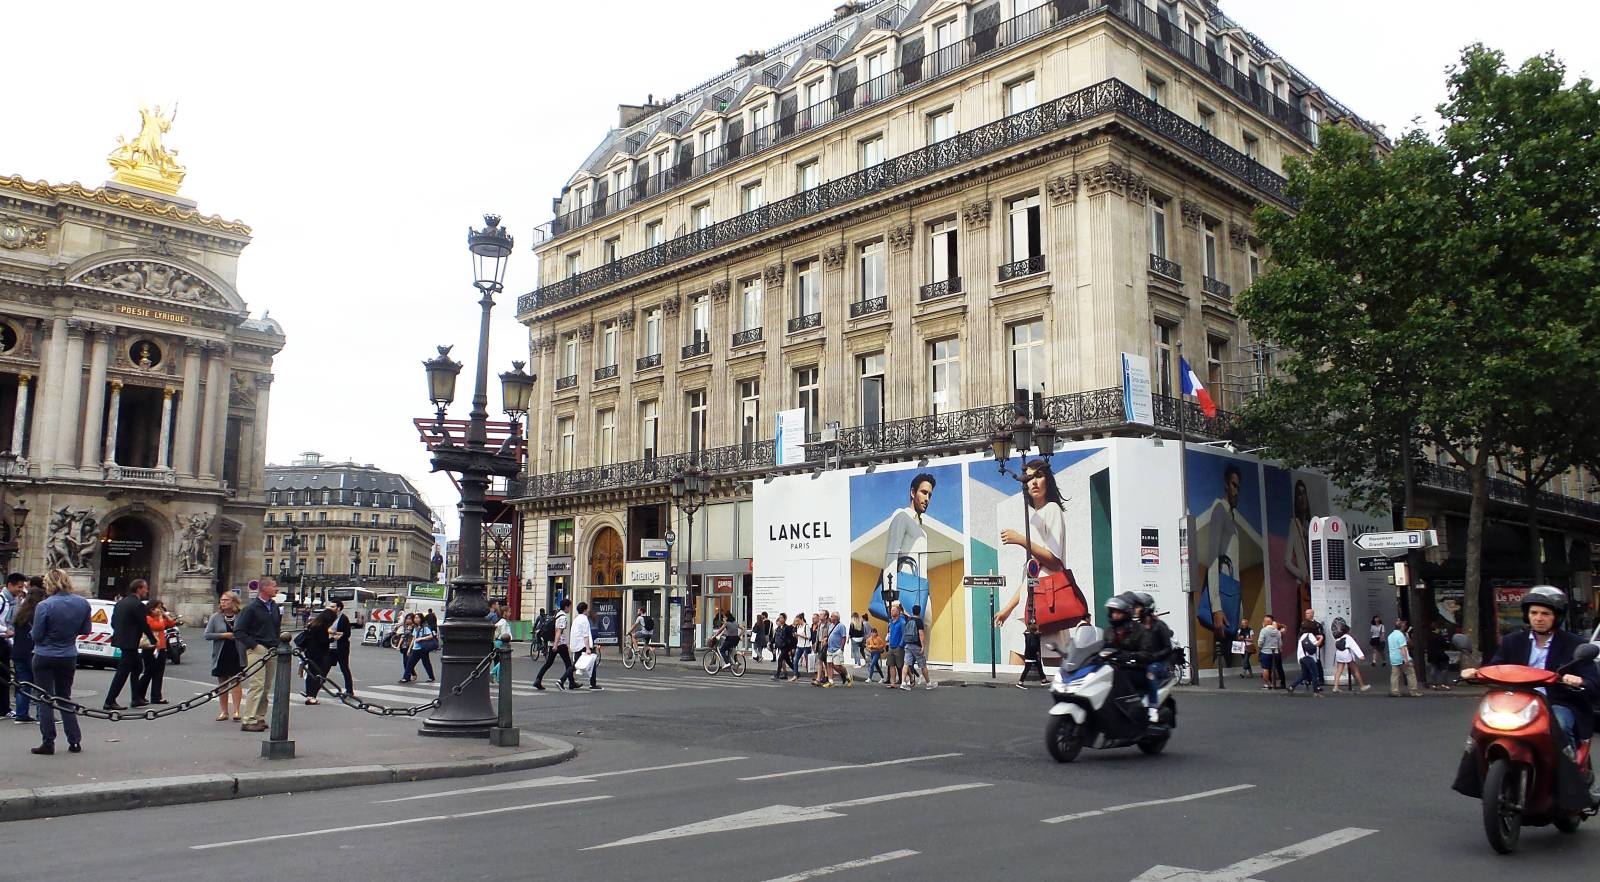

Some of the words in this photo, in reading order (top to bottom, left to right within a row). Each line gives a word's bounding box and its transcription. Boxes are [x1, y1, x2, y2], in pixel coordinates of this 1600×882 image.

[770, 521, 832, 541] LANCEL
[790, 542, 810, 550] PARIS
[631, 571, 659, 583] Change
